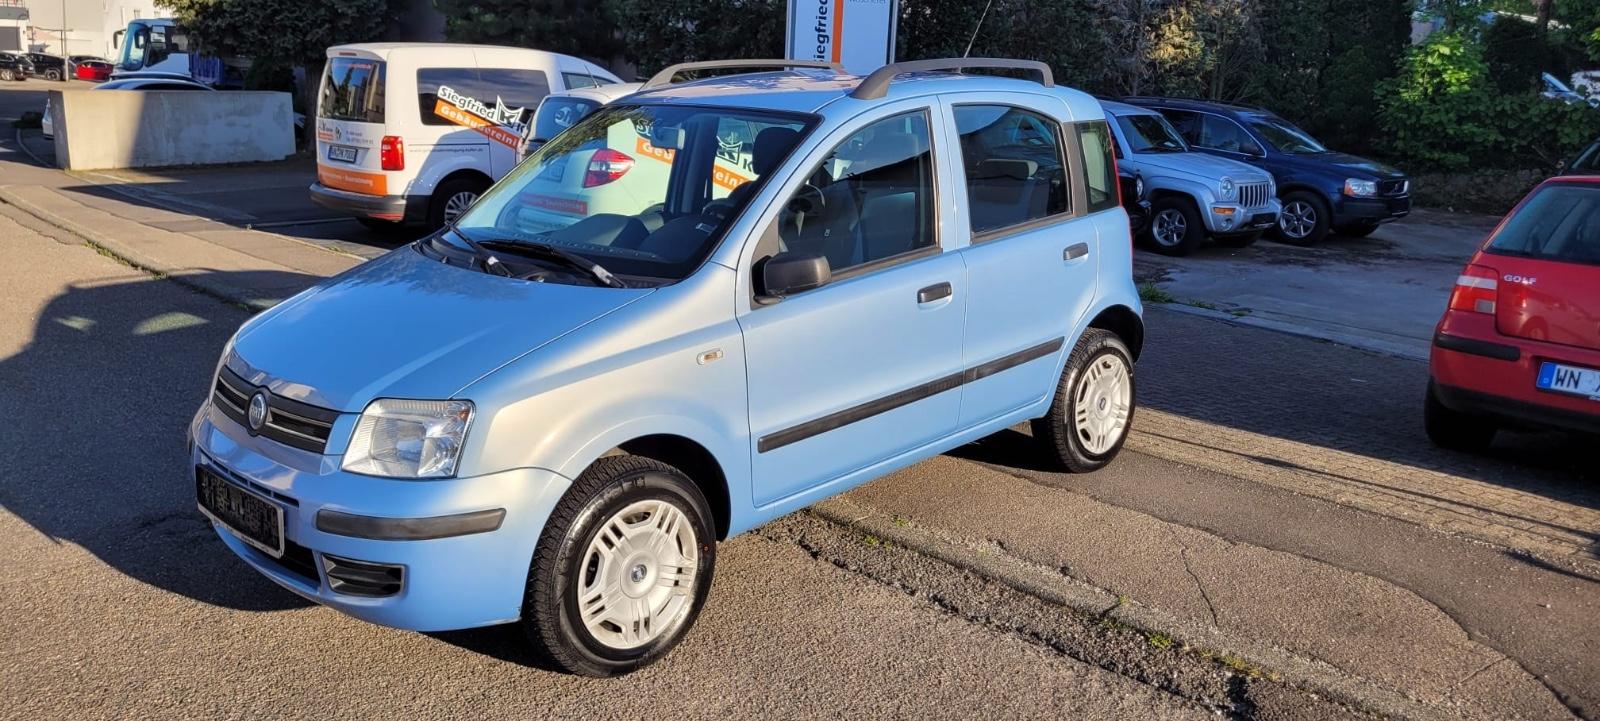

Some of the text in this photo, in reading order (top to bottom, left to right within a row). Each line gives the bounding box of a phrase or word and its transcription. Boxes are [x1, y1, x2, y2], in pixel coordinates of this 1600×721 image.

[814, 0, 830, 62] iegfrie
[440, 86, 495, 119] Siegfried
[440, 105, 519, 147] Gebäudereini
[1503, 274, 1537, 285] GOLF
[1555, 367, 1581, 389] WN
